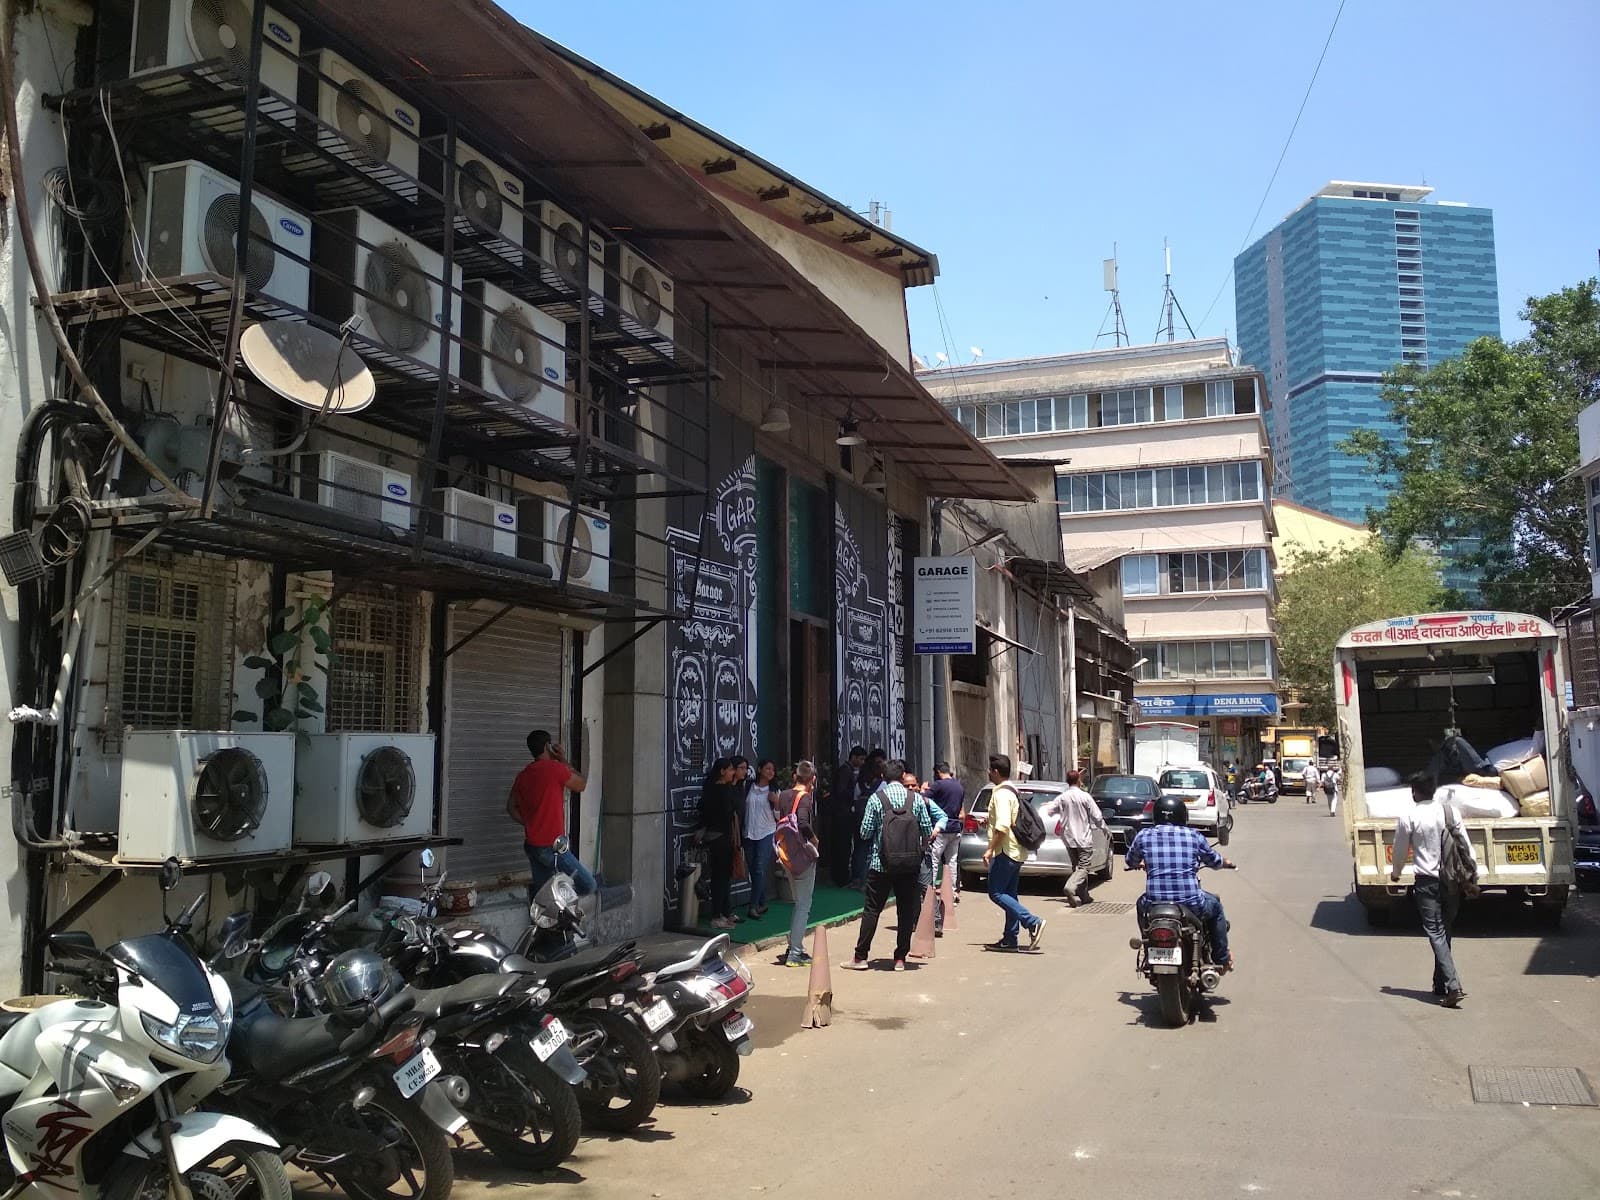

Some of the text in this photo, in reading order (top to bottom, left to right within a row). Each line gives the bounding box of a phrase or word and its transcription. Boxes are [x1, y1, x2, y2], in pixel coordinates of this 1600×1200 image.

[281, 220, 303, 234] Carrier
[918, 567, 968, 576] GARAGE
[1214, 697, 1262, 706] DENA BANK
